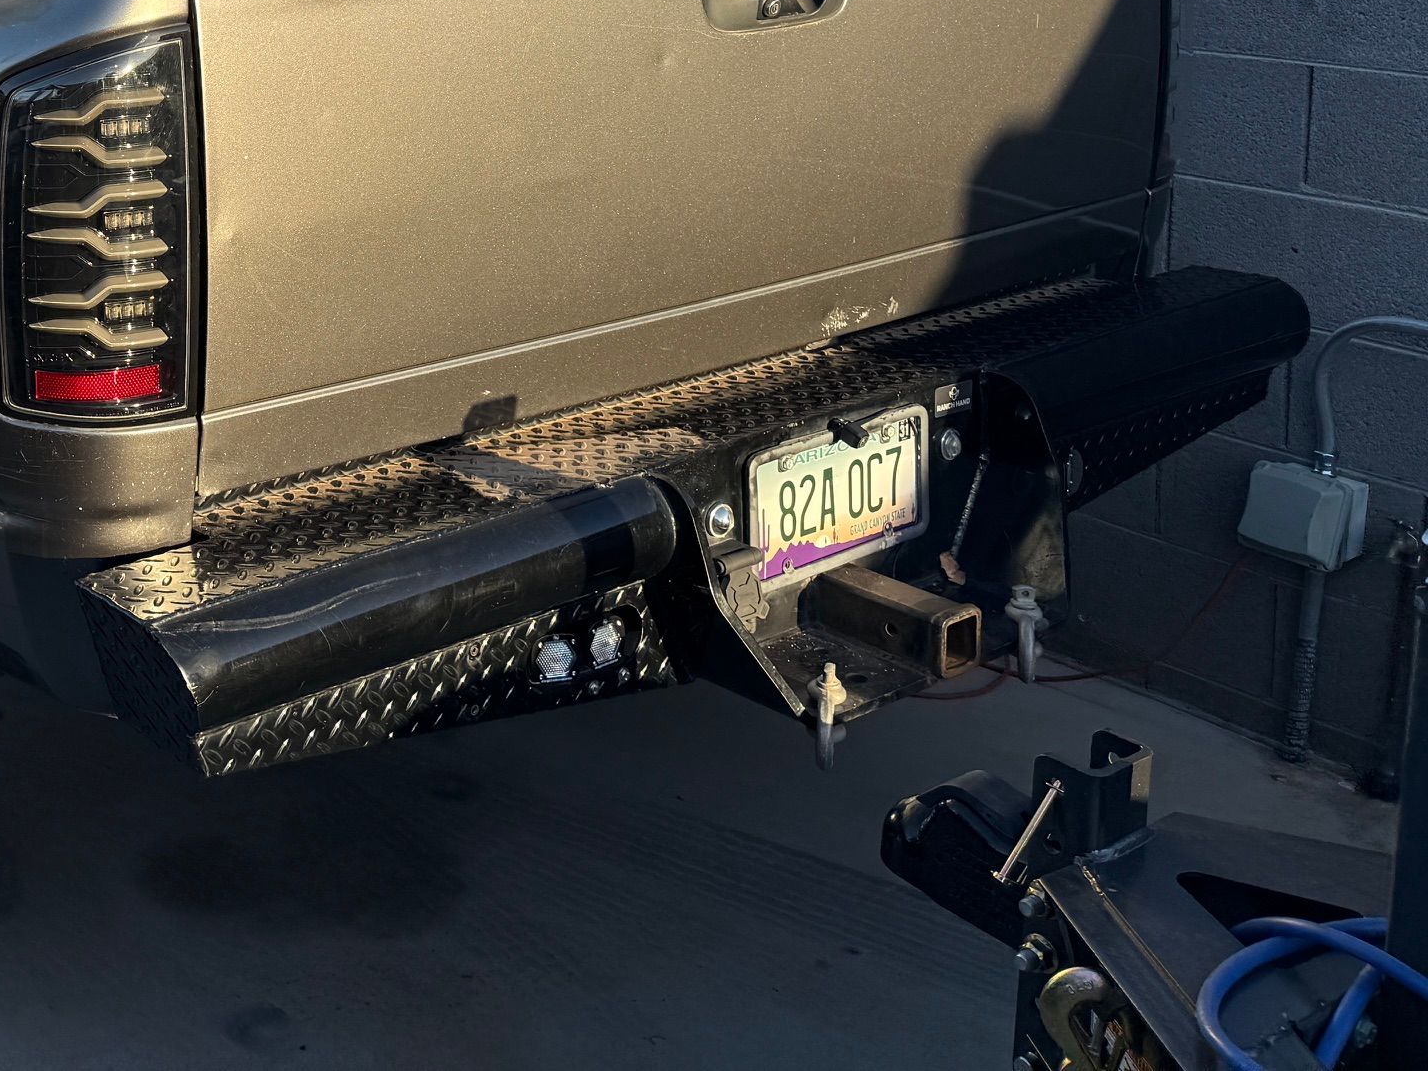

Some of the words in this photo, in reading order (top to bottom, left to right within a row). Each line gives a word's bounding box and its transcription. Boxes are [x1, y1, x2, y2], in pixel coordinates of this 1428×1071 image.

[793, 431, 877, 464] ARIZOA
[779, 467, 836, 542] 82A
[891, 507, 906, 521] STATE
